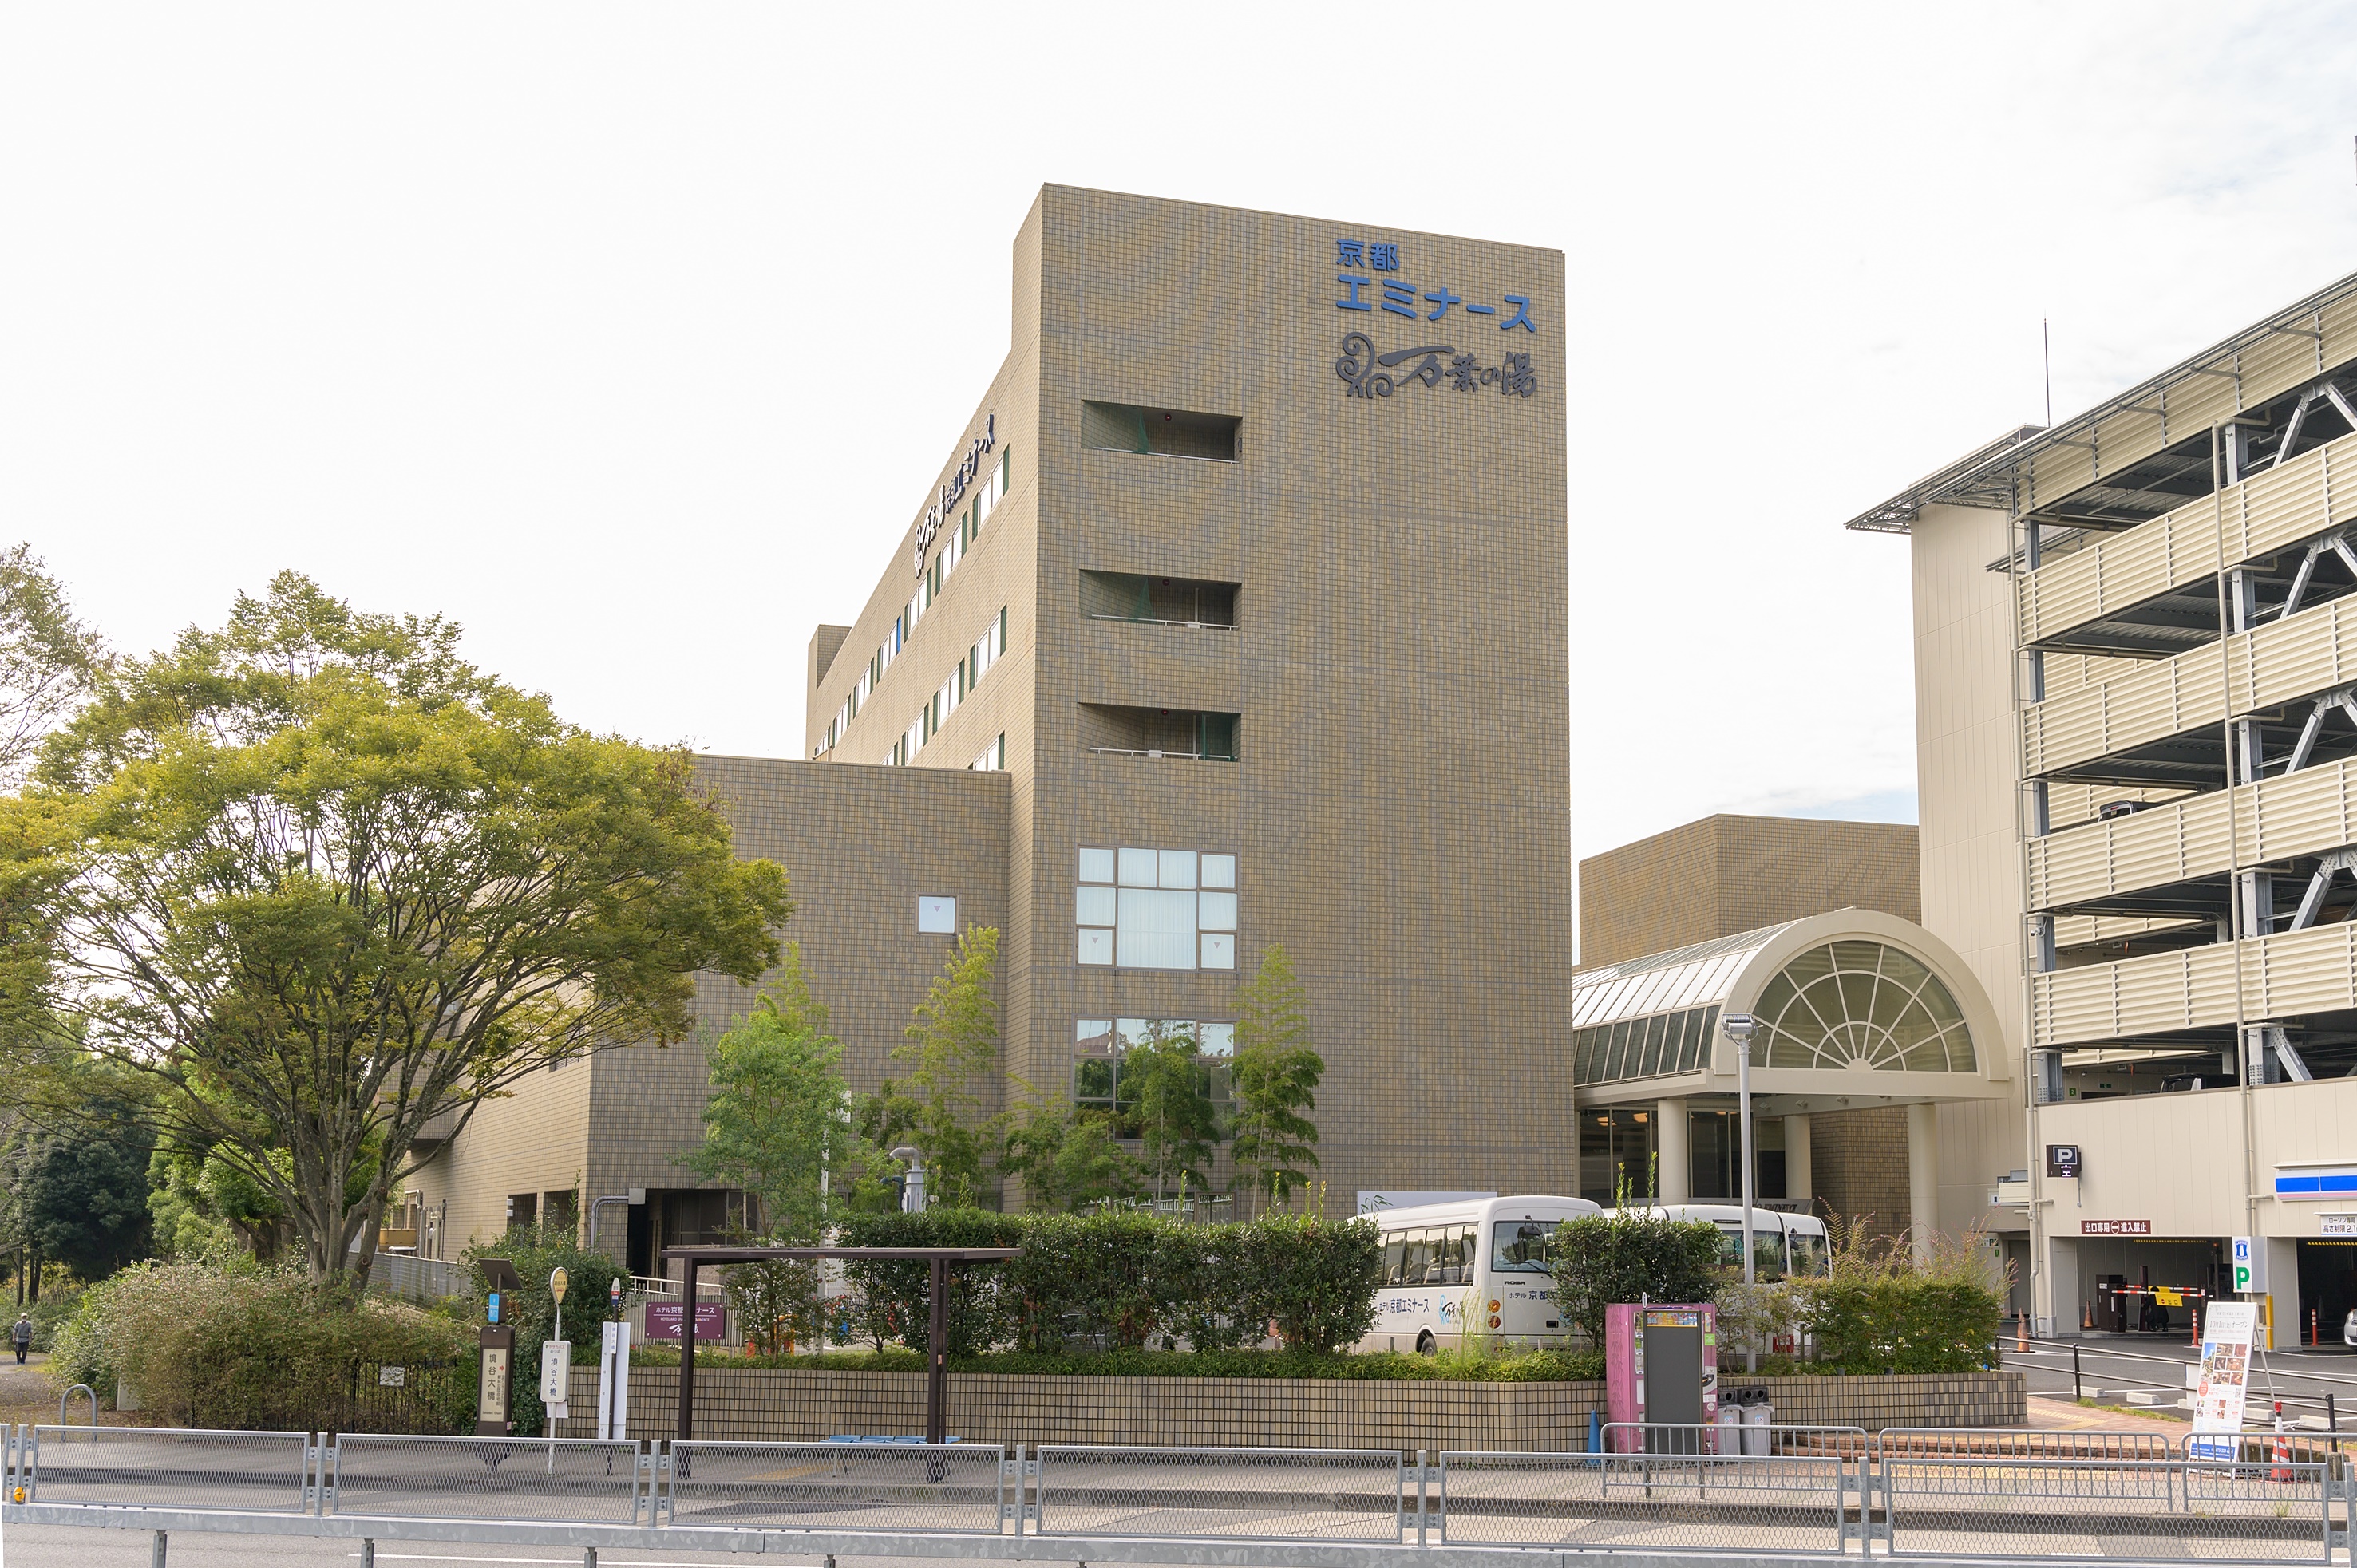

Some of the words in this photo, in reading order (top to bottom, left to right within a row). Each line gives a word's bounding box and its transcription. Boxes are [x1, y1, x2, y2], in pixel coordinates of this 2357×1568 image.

[1336, 239, 1400, 271] 京都
[1336, 274, 1536, 332] エミナース
[1378, 345, 1537, 397] 万葉の湯
[2058, 1148, 2073, 1163] P
[2060, 1164, 2072, 1177] 空
[2085, 1222, 2110, 1233] 出口専用
[2121, 1222, 2147, 1233] 進入禁止
[2323, 1224, 2357, 1233] 高さ制限2.1
[2236, 1266, 2250, 1290] P
[487, 1353, 497, 1400] 境谷大橋
[549, 1358, 558, 1396] 境谷大橋
